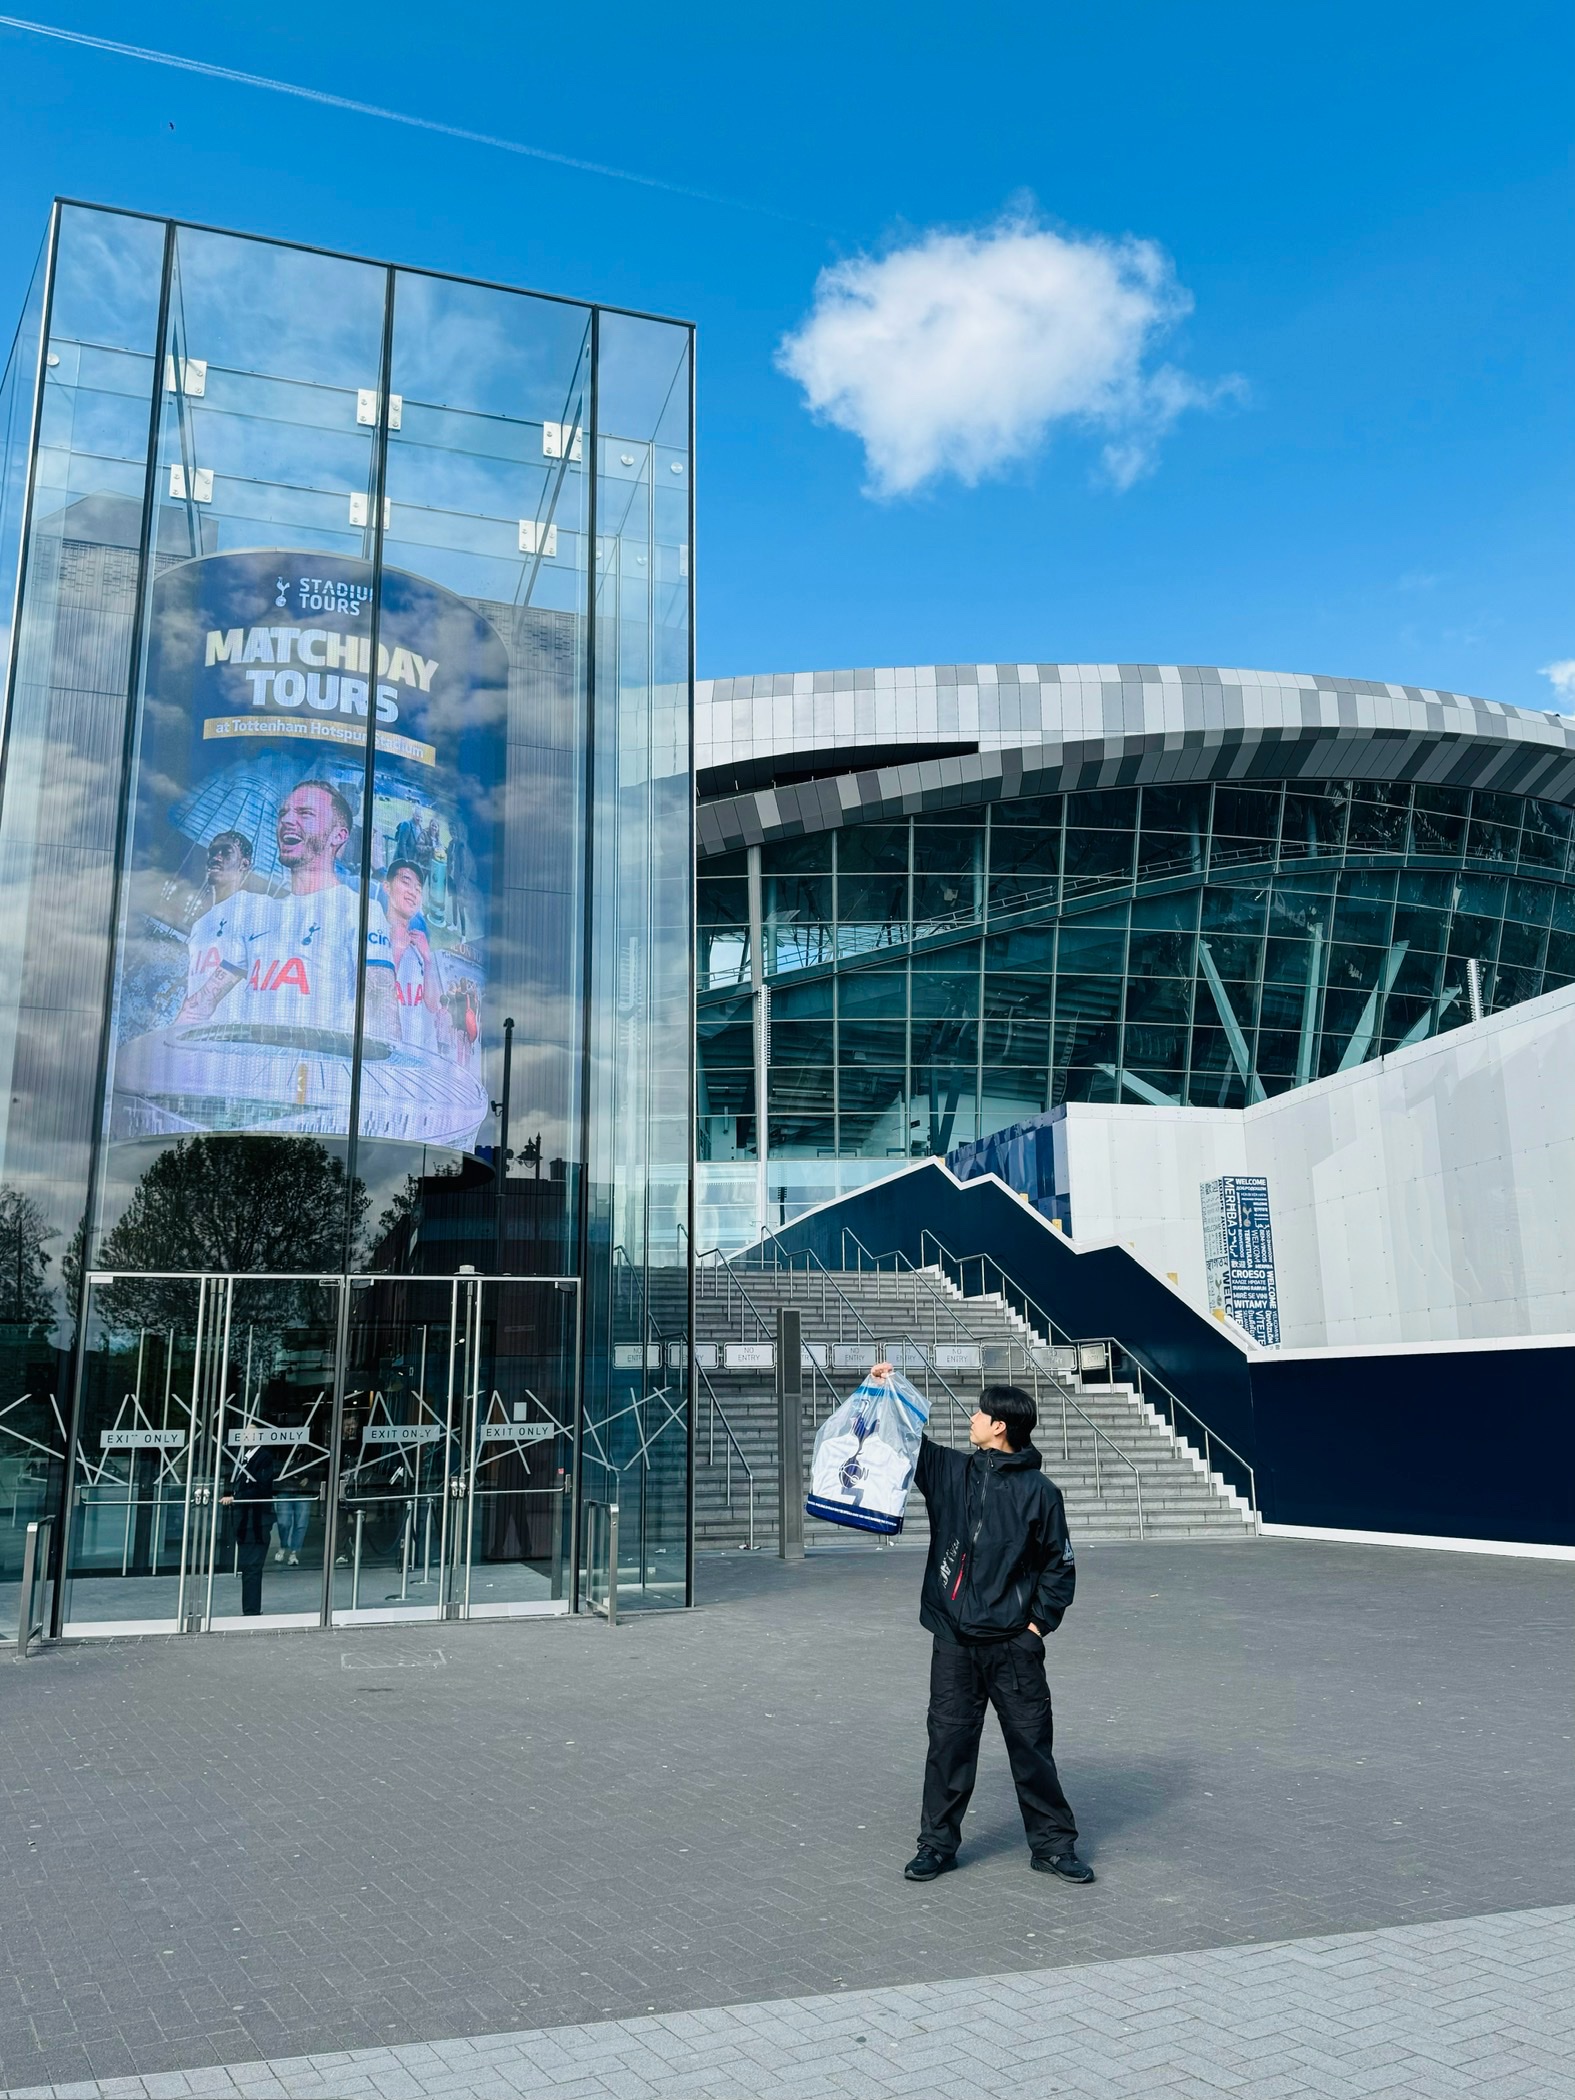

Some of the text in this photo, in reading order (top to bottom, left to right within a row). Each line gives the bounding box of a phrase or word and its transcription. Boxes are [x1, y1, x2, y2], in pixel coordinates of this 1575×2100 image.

[299, 577, 373, 602] STADIU
[298, 592, 360, 617] TOURS
[204, 626, 439, 693] MATCHDAY
[246, 669, 399, 723] TOURS
[215, 721, 231, 734] at
[231, 719, 308, 734] Tottenham
[310, 722, 369, 742] Hotspur
[1224, 1178, 1238, 1228] MERHBA
[1251, 1230, 1261, 1263] WELKOM
[1231, 1269, 1266, 1279] CROESO
[1222, 1271, 1233, 1318] WELC
[1266, 1270, 1277, 1309] WELCOME
[1234, 1299, 1268, 1308] WITAMY
[144, 1433, 178, 1443] ONLY
[234, 1431, 304, 1442] EXIT ONLY
[371, 1430, 398, 1439] EXIT
[486, 1427, 550, 1437] EXIT ONLY
